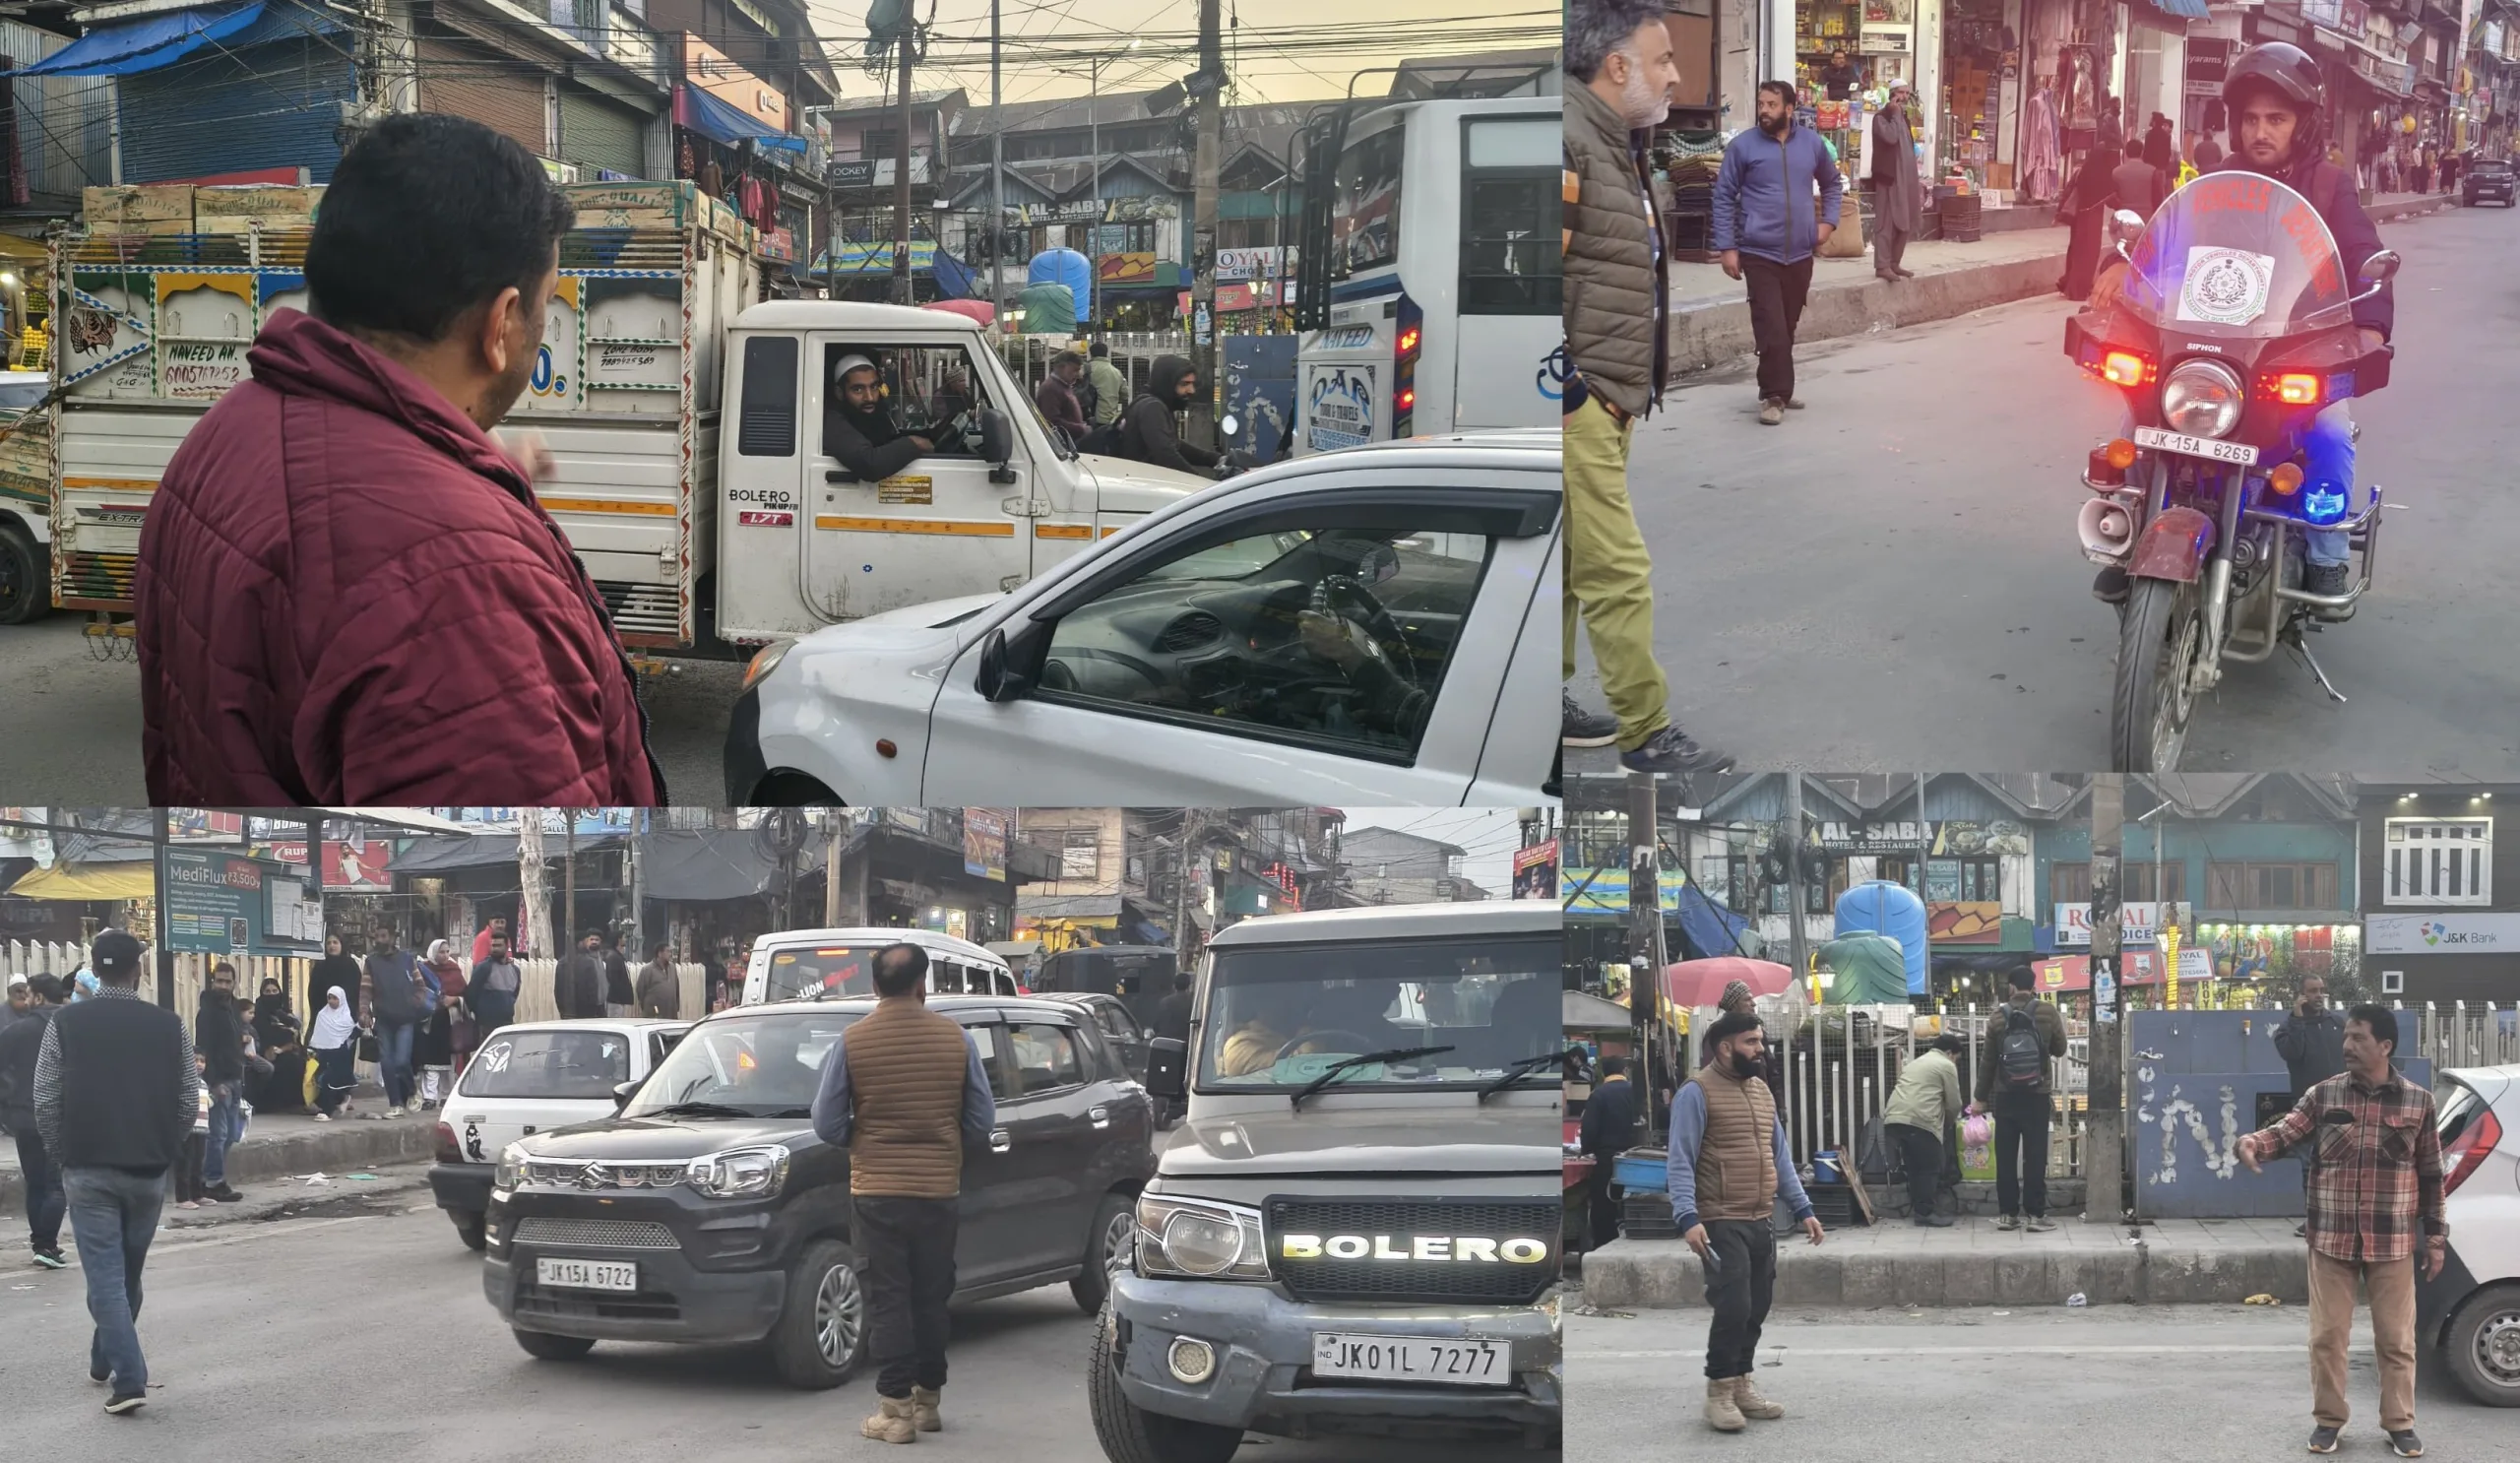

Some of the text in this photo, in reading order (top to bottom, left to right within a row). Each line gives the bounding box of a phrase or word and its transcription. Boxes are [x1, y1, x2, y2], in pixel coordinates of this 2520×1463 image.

[2187, 55, 2222, 64] iyarams
[833, 166, 867, 176] OCKEY
[1029, 199, 1107, 216] AL- SABA
[1221, 251, 1275, 267] OYAL
[1231, 266, 1275, 276] CHOE
[169, 345, 216, 362] NAVEED
[2186, 343, 2222, 353] SIPHON
[2151, 433, 2168, 447] JK
[2174, 436, 2200, 453] 15A
[728, 489, 789, 503] BOLERO
[1821, 821, 1934, 841] AL- SABA
[284, 848, 308, 857] RUP
[1825, 840, 1929, 850] HOTEL & RESTAURET
[170, 865, 227, 885] MediFlux
[2069, 908, 2151, 928] RAL
[2443, 932, 2497, 944] J&K Bank
[1283, 1235, 1547, 1264] BOLERO
[597, 1266, 632, 1287] 6722
[1317, 1342, 1496, 1376] IND JK01L 7277
